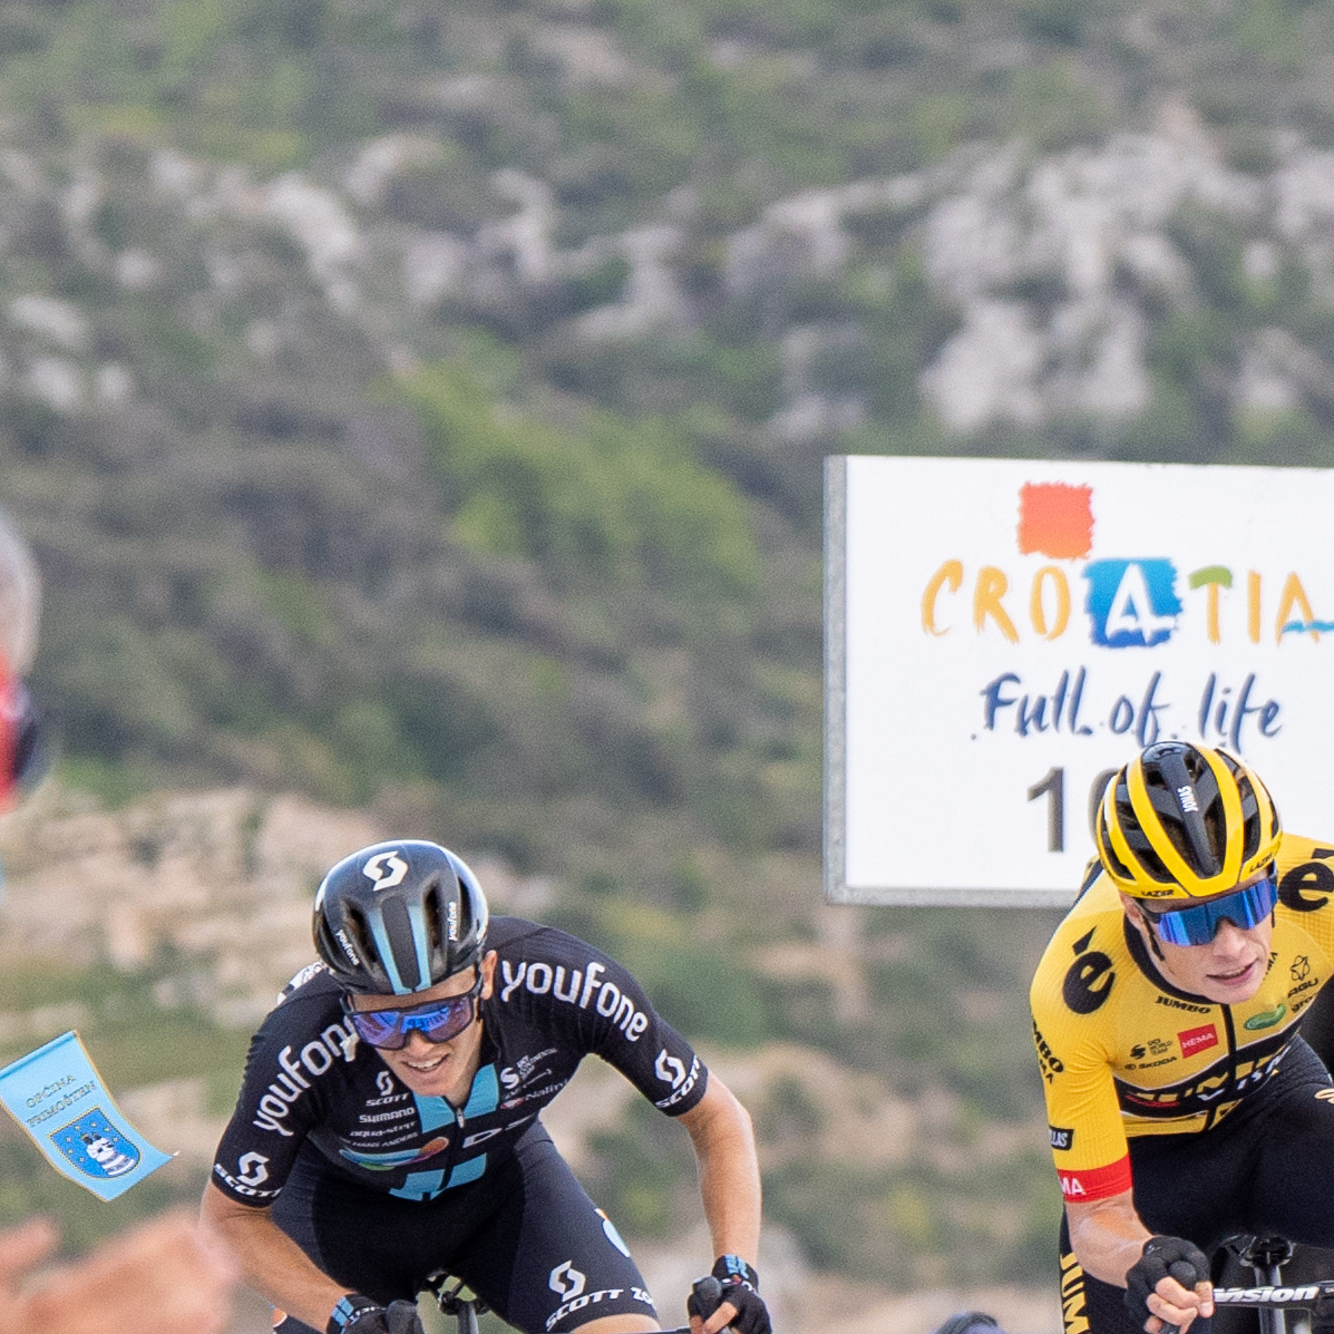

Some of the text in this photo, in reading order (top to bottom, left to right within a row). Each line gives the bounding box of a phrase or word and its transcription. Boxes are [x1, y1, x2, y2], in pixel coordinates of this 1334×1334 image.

[979, 666, 1283, 752] Full of life
[501, 961, 649, 1042] youfone
[1155, 995, 1211, 1014] JUMBO
[1181, 1032, 1215, 1049] HEMA
[655, 1054, 700, 1108] SCOTT
[358, 1107, 415, 1123] SHIMANO
[365, 1092, 409, 1107] SCOTT
[546, 1288, 625, 1332] SCOTT
